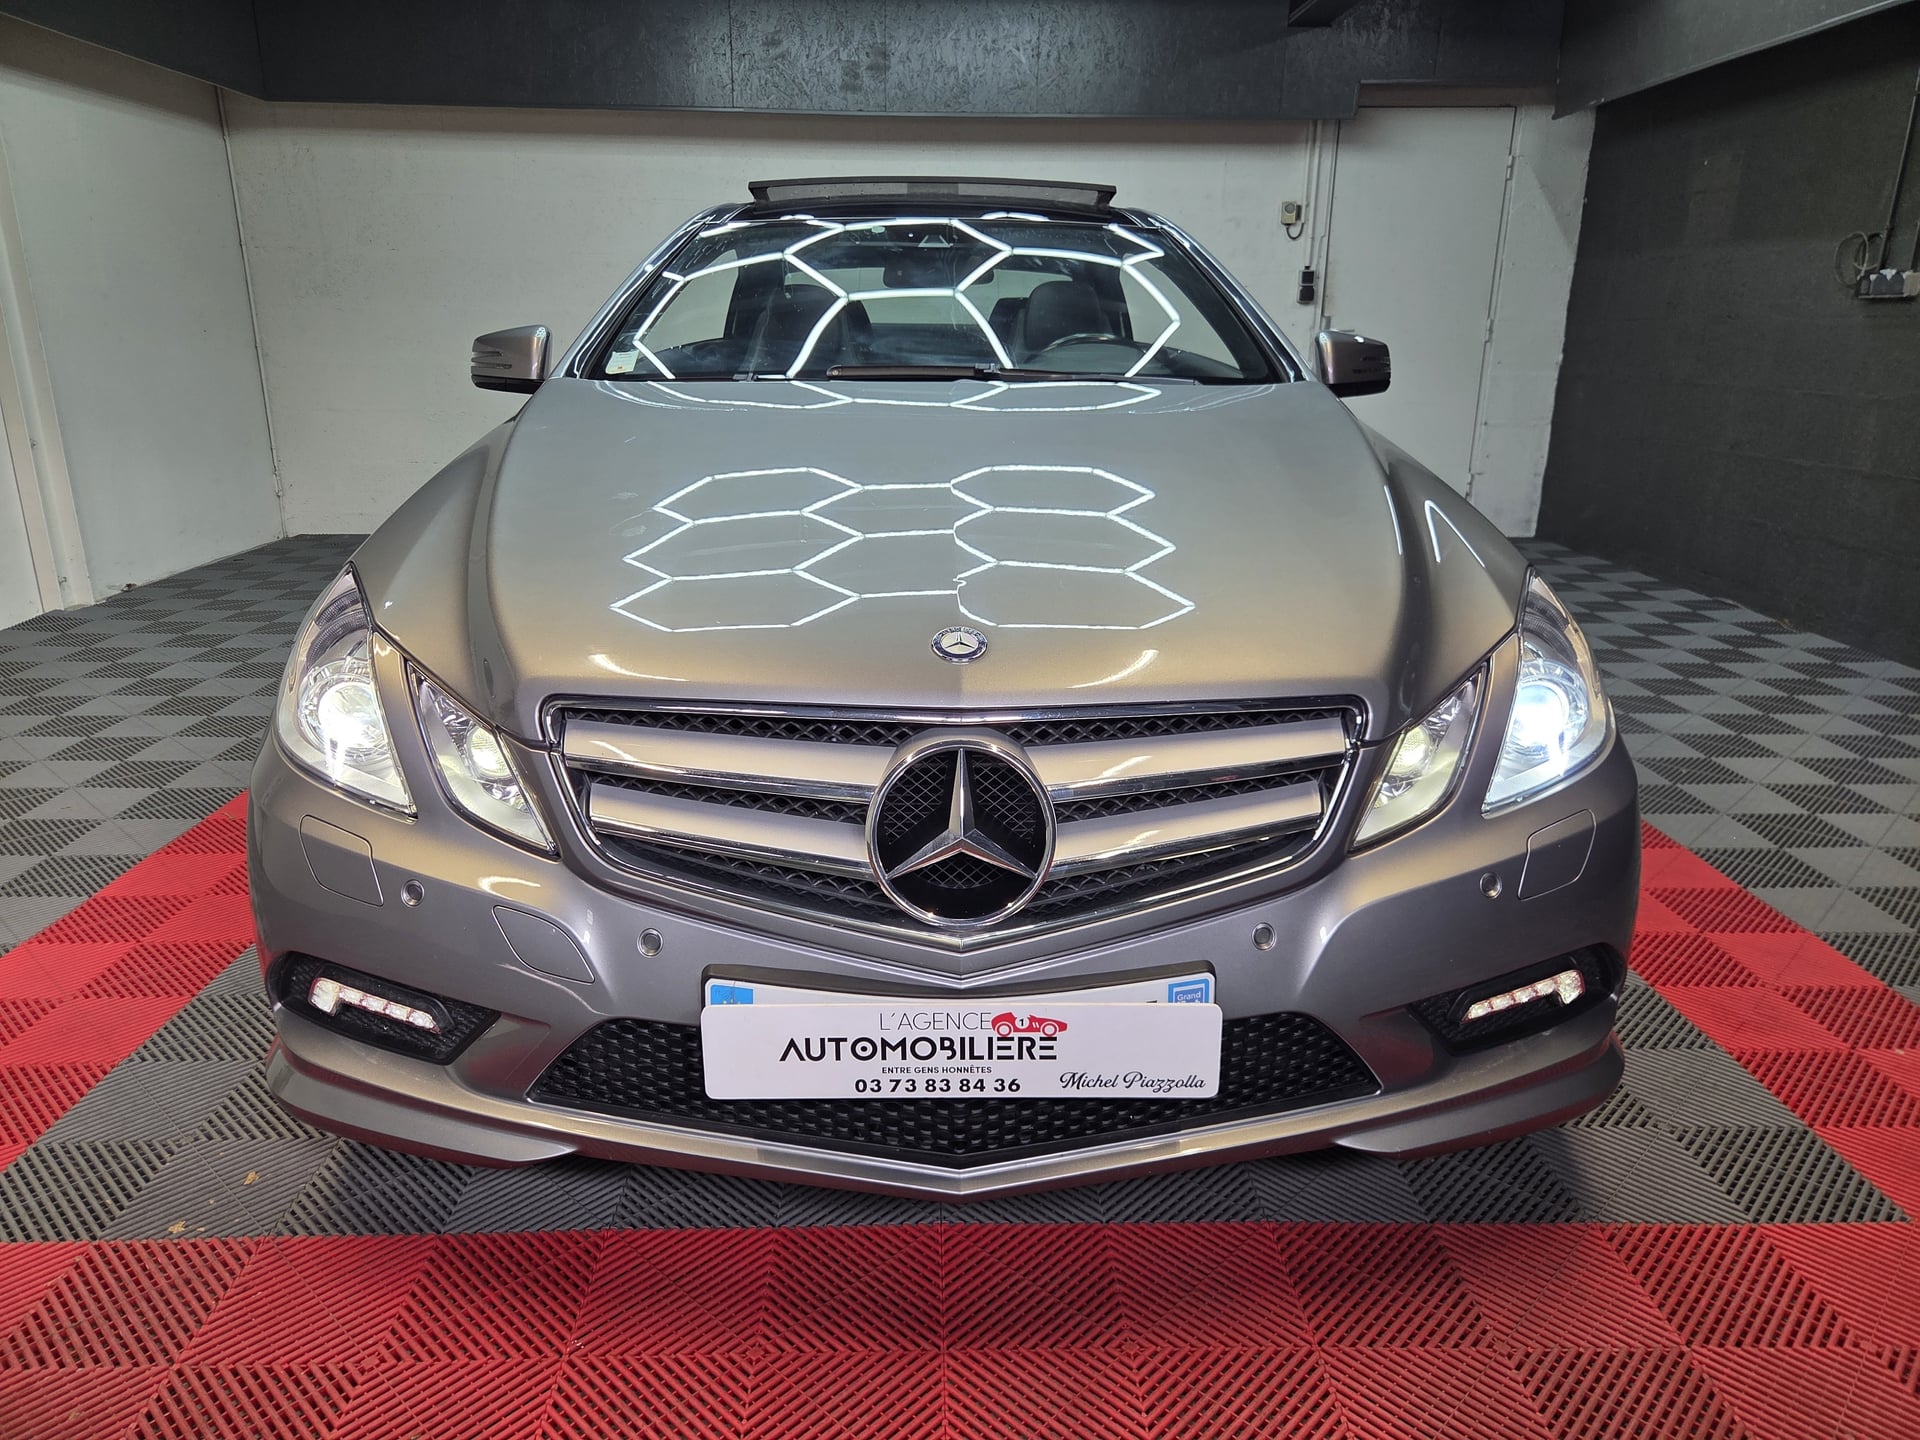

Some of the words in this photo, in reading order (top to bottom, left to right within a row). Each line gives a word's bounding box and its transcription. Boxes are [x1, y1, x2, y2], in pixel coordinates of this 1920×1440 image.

[1177, 991, 1201, 1001] Grand
[879, 1012, 992, 1031] L'AGENCE
[1018, 1018, 1025, 1027] 1
[881, 1066, 912, 1074] ENTRE
[914, 1066, 940, 1074] GENS
[942, 1064, 992, 1074] HONNÊTES
[855, 1078, 882, 1093] 03
[889, 1078, 917, 1093] 73
[925, 1078, 952, 1093] 83
[959, 1078, 986, 1093] 84
[994, 1078, 1021, 1093] 36
[1059, 1071, 1120, 1090] Michel
[1123, 1071, 1206, 1094] Piazzolla
